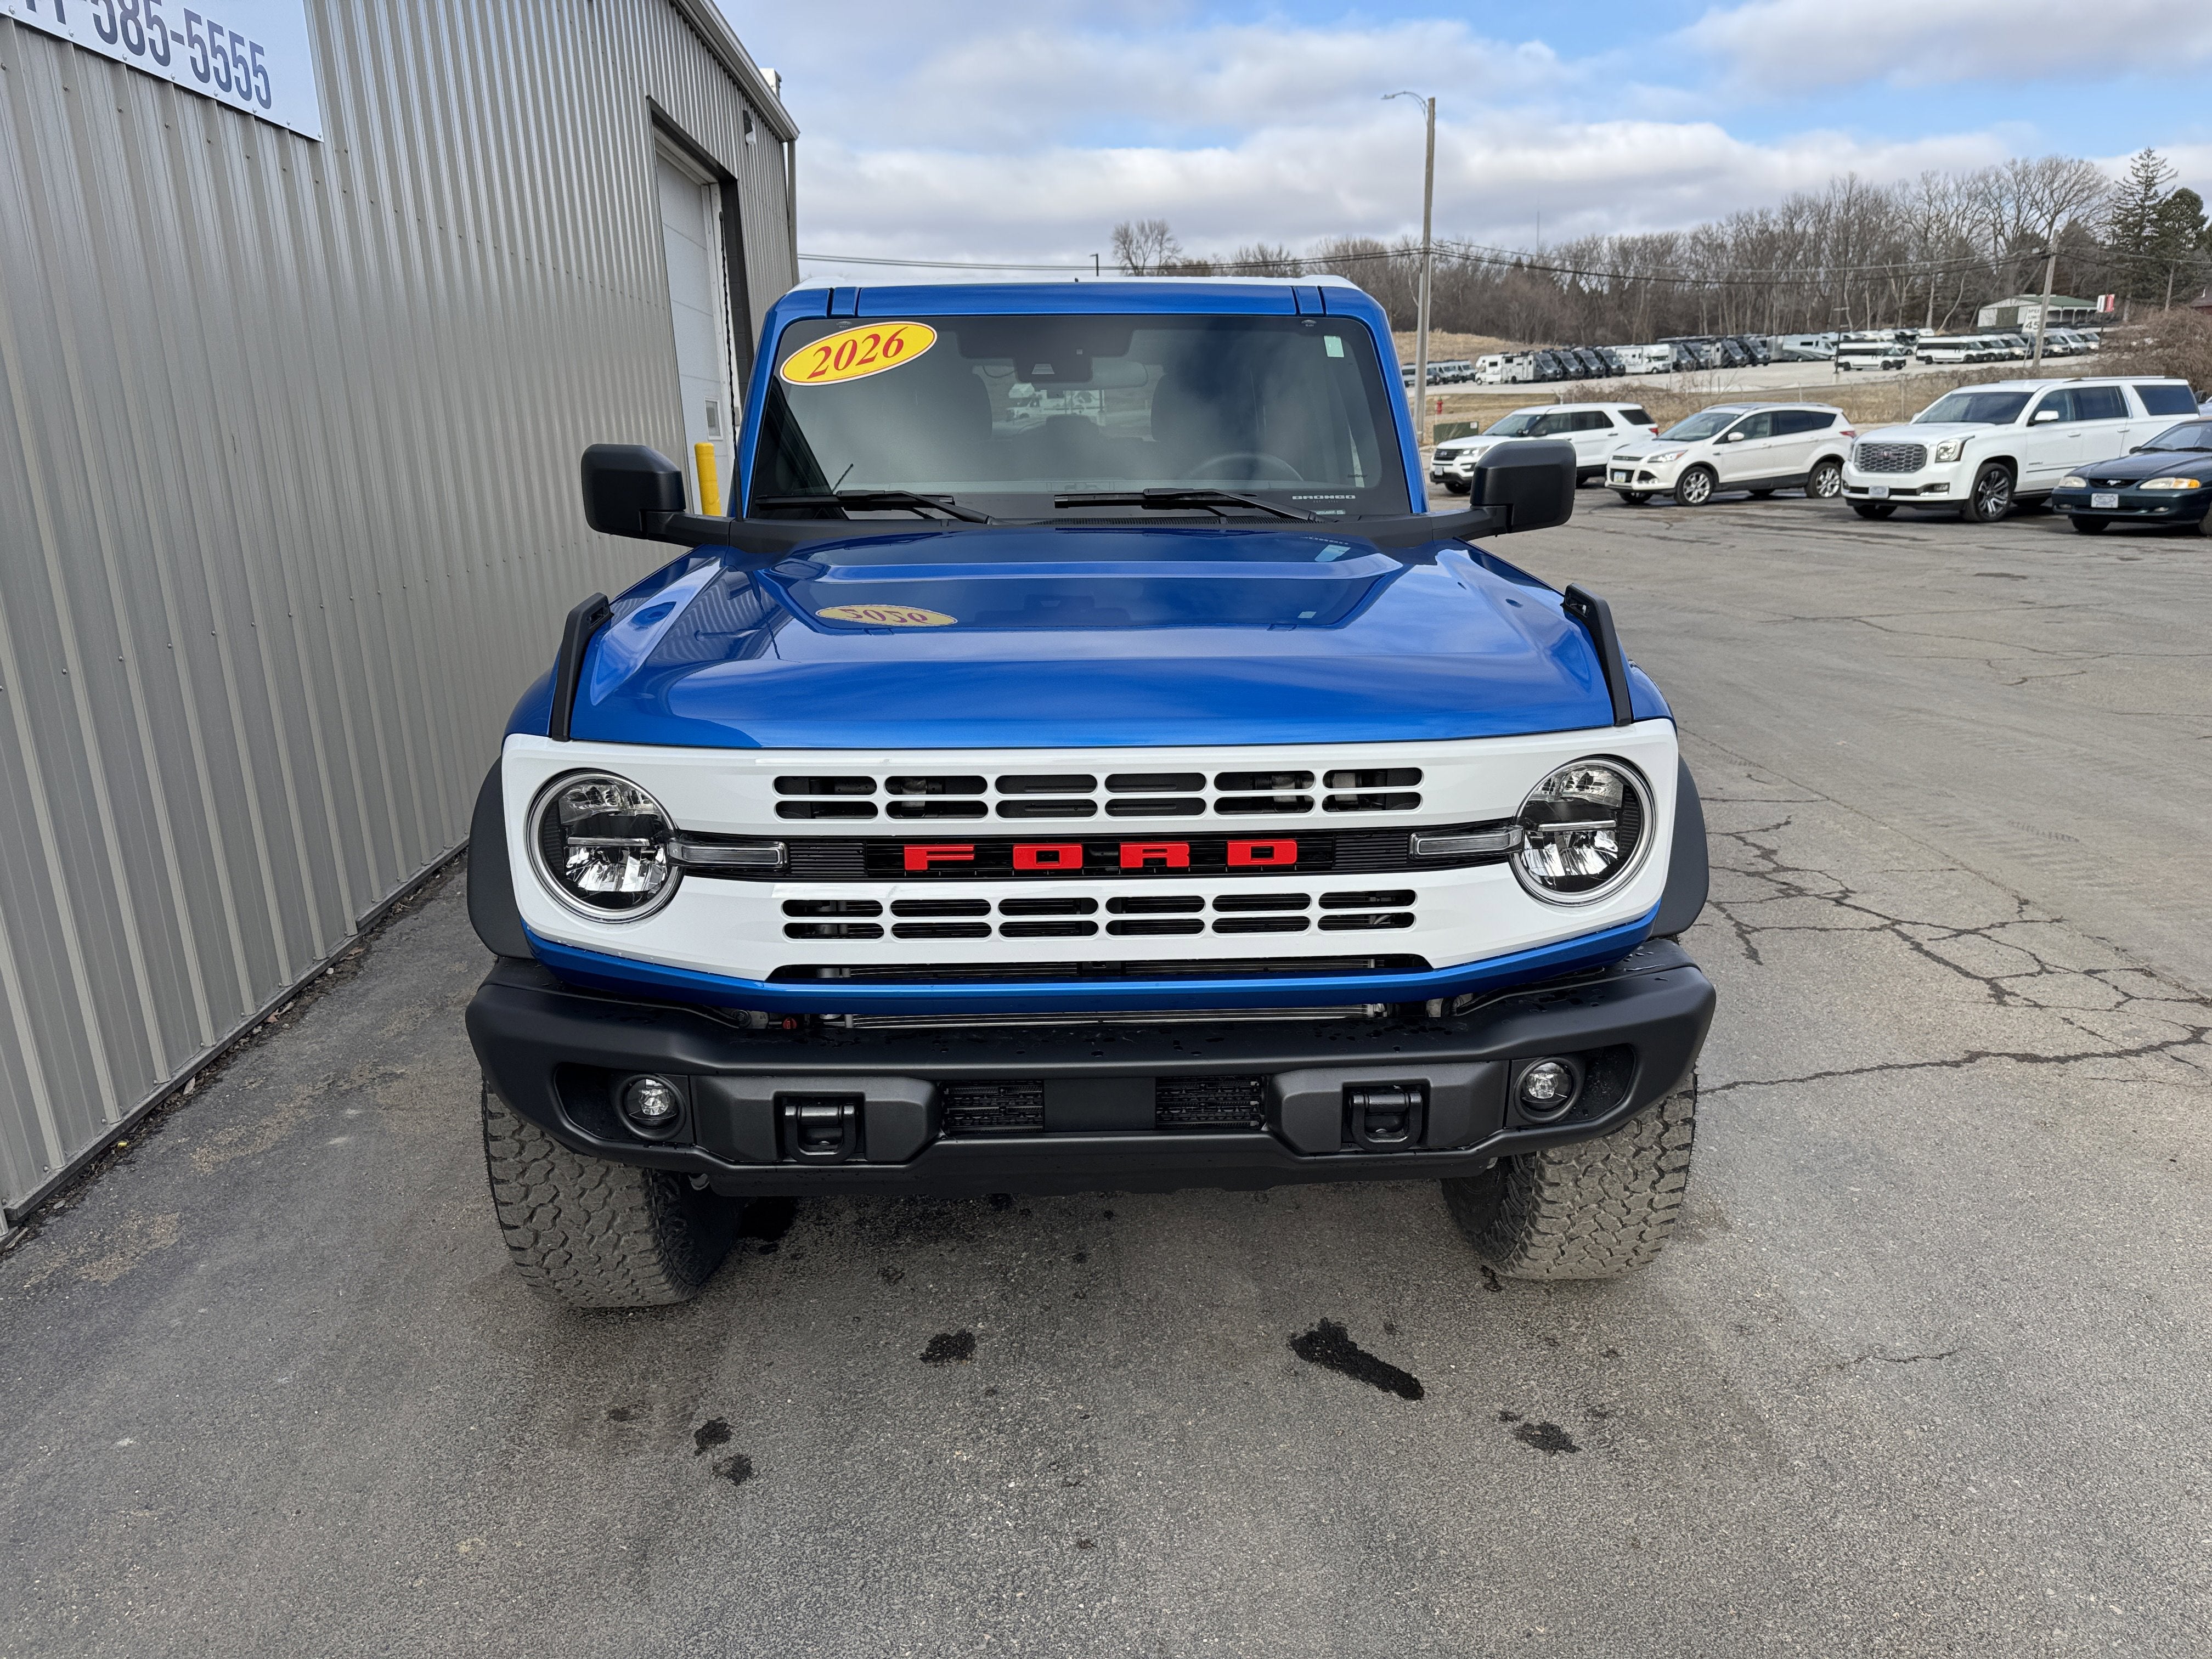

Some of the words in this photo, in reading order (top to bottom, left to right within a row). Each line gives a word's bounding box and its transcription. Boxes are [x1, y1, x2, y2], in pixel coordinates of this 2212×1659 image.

[25, 0, 272, 110] 585-5555
[2025, 321, 2041, 330] 45
[806, 326, 909, 379] 2026
[904, 838, 1298, 871] FORD
